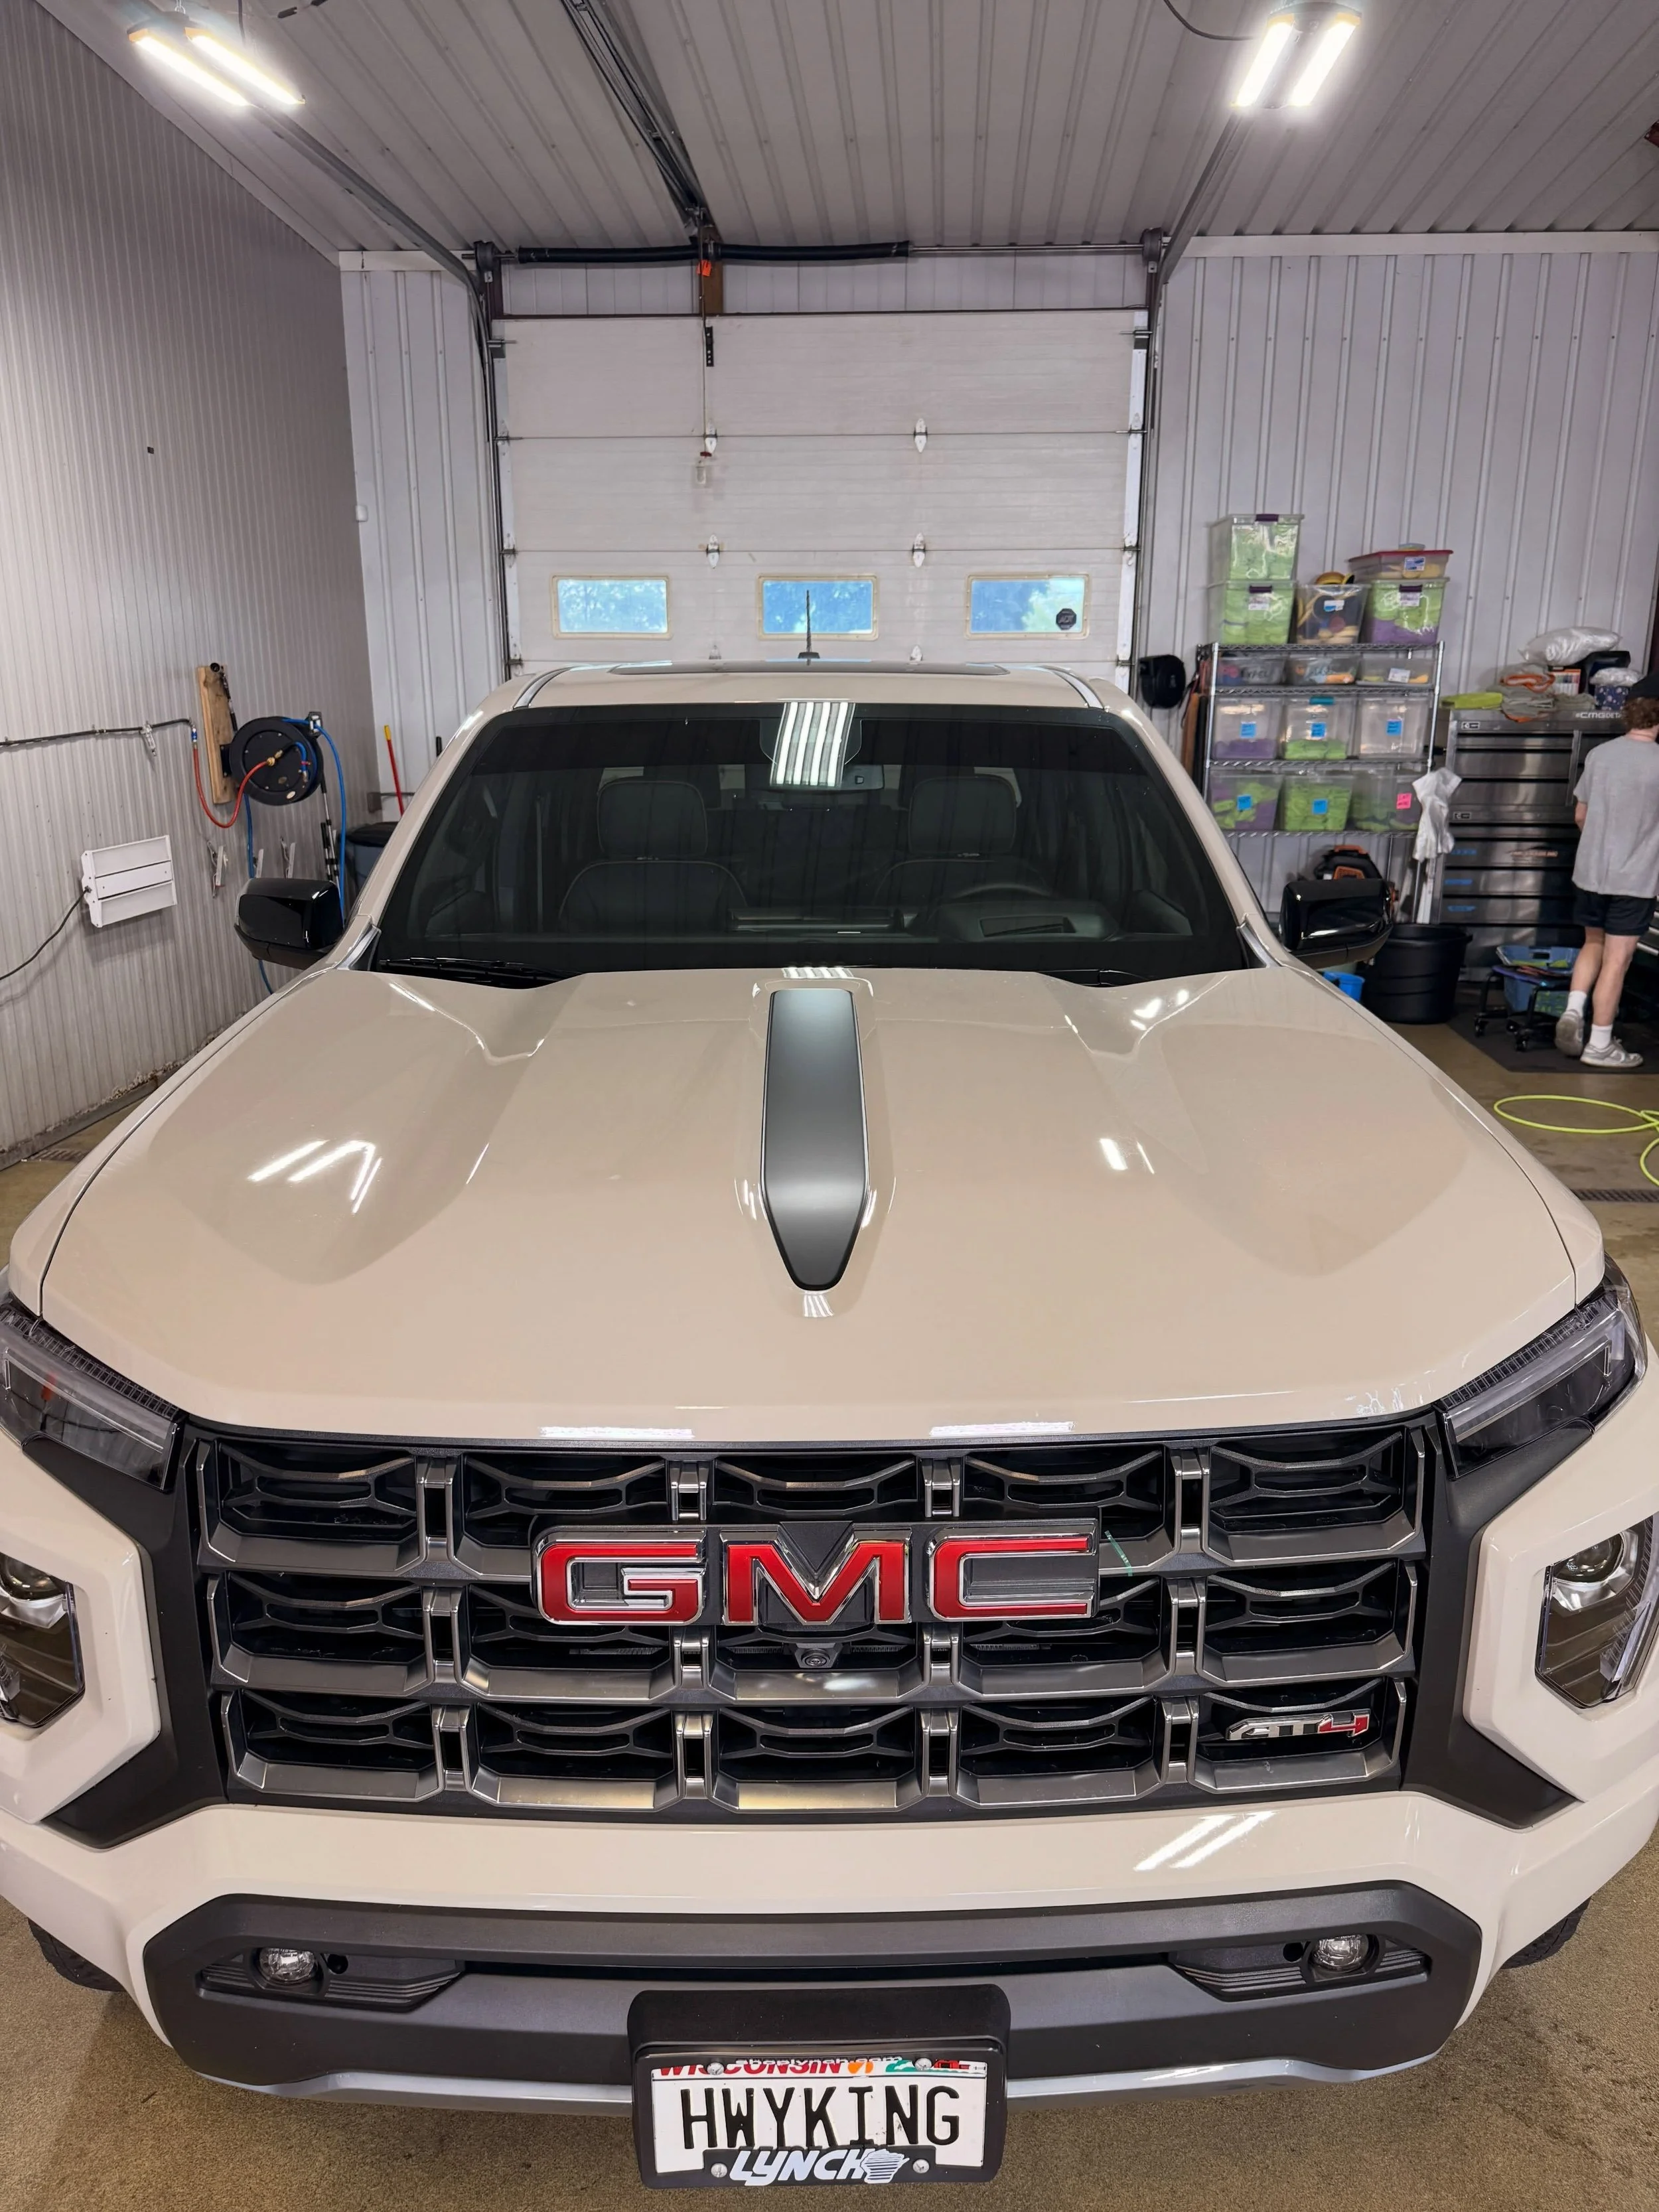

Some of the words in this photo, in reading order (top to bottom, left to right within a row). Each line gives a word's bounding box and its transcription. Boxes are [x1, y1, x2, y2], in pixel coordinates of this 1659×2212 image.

[535, 1522, 1099, 1625] GMC
[1226, 1709, 1371, 1741] AT4
[680, 2084, 960, 2150] HWYKING
[729, 2148, 876, 2186] LYNCH
